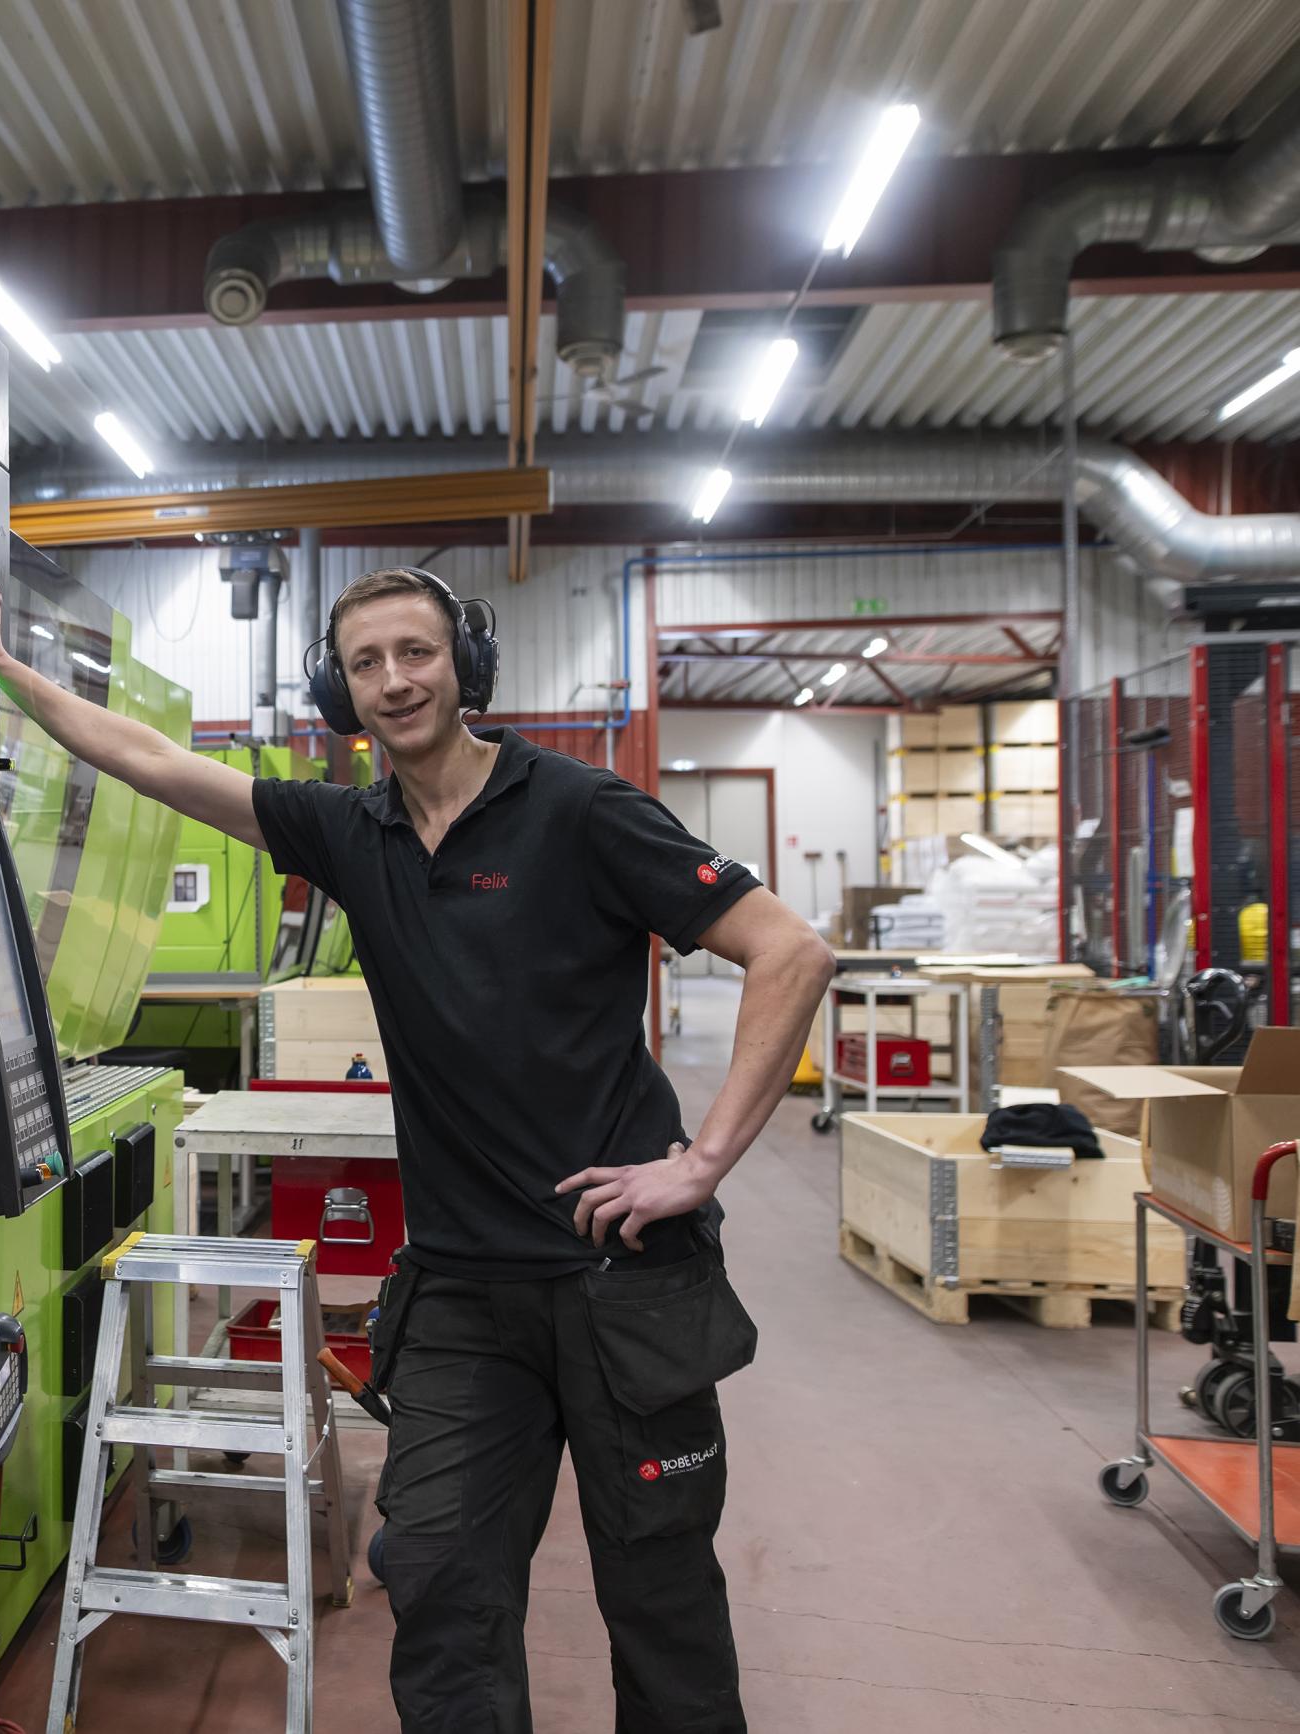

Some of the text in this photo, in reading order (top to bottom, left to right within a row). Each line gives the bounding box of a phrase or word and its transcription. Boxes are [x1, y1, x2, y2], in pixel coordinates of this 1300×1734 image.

[472, 872, 509, 890] Felix
[660, 1455, 691, 1472] BOBE
[691, 1442, 718, 1464] PLAST
